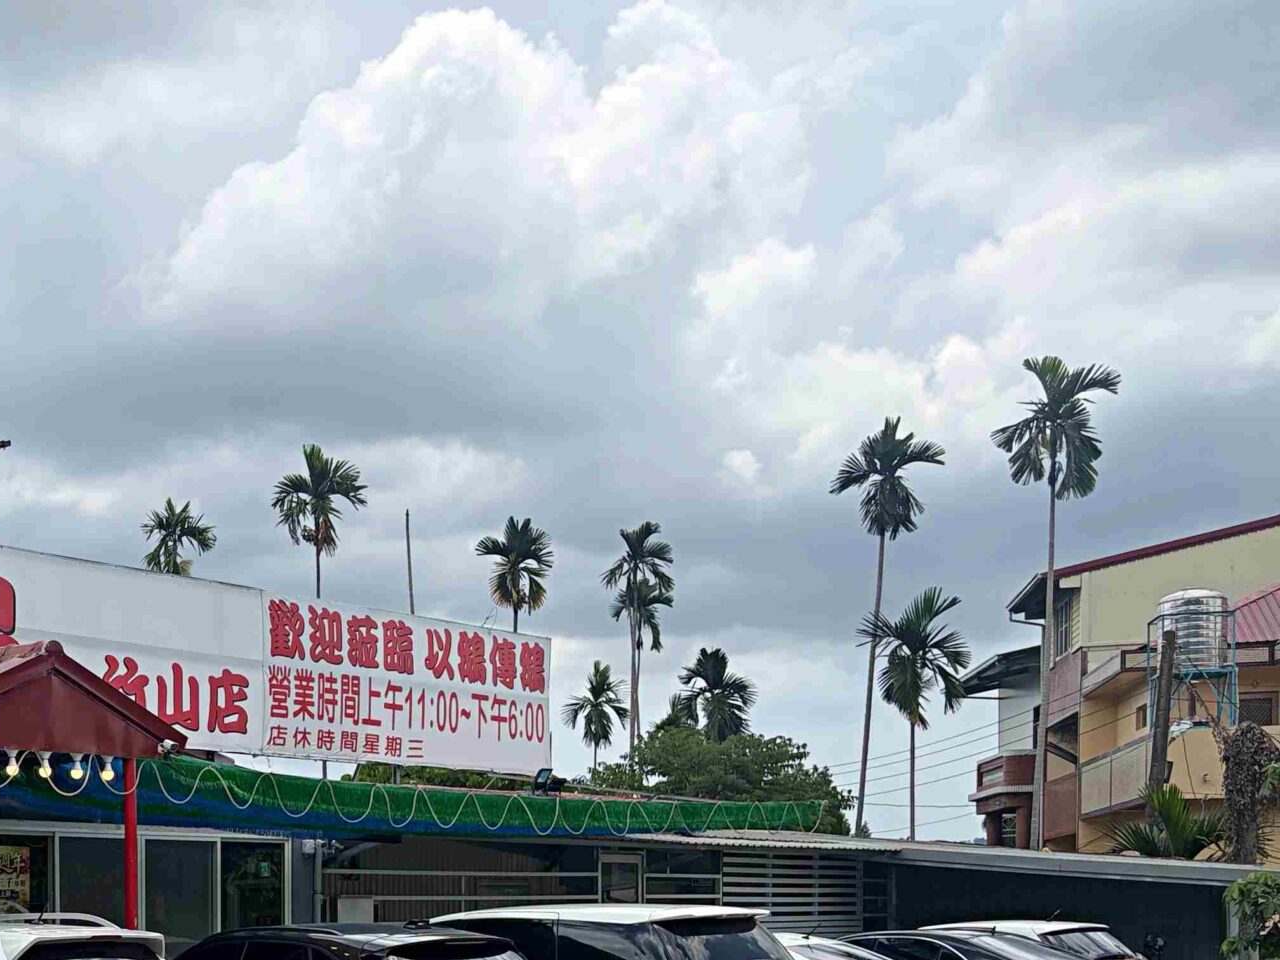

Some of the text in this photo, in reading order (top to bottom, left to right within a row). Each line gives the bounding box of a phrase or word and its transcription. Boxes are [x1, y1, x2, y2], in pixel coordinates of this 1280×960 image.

[268, 599, 546, 694] 歡迎蒞臨 以鵝傳鵝
[103, 655, 249, 734] 竹山店
[268, 665, 546, 743] 營業時間上午11:00~下午6:00
[267, 725, 424, 759] 店休時間星期三
